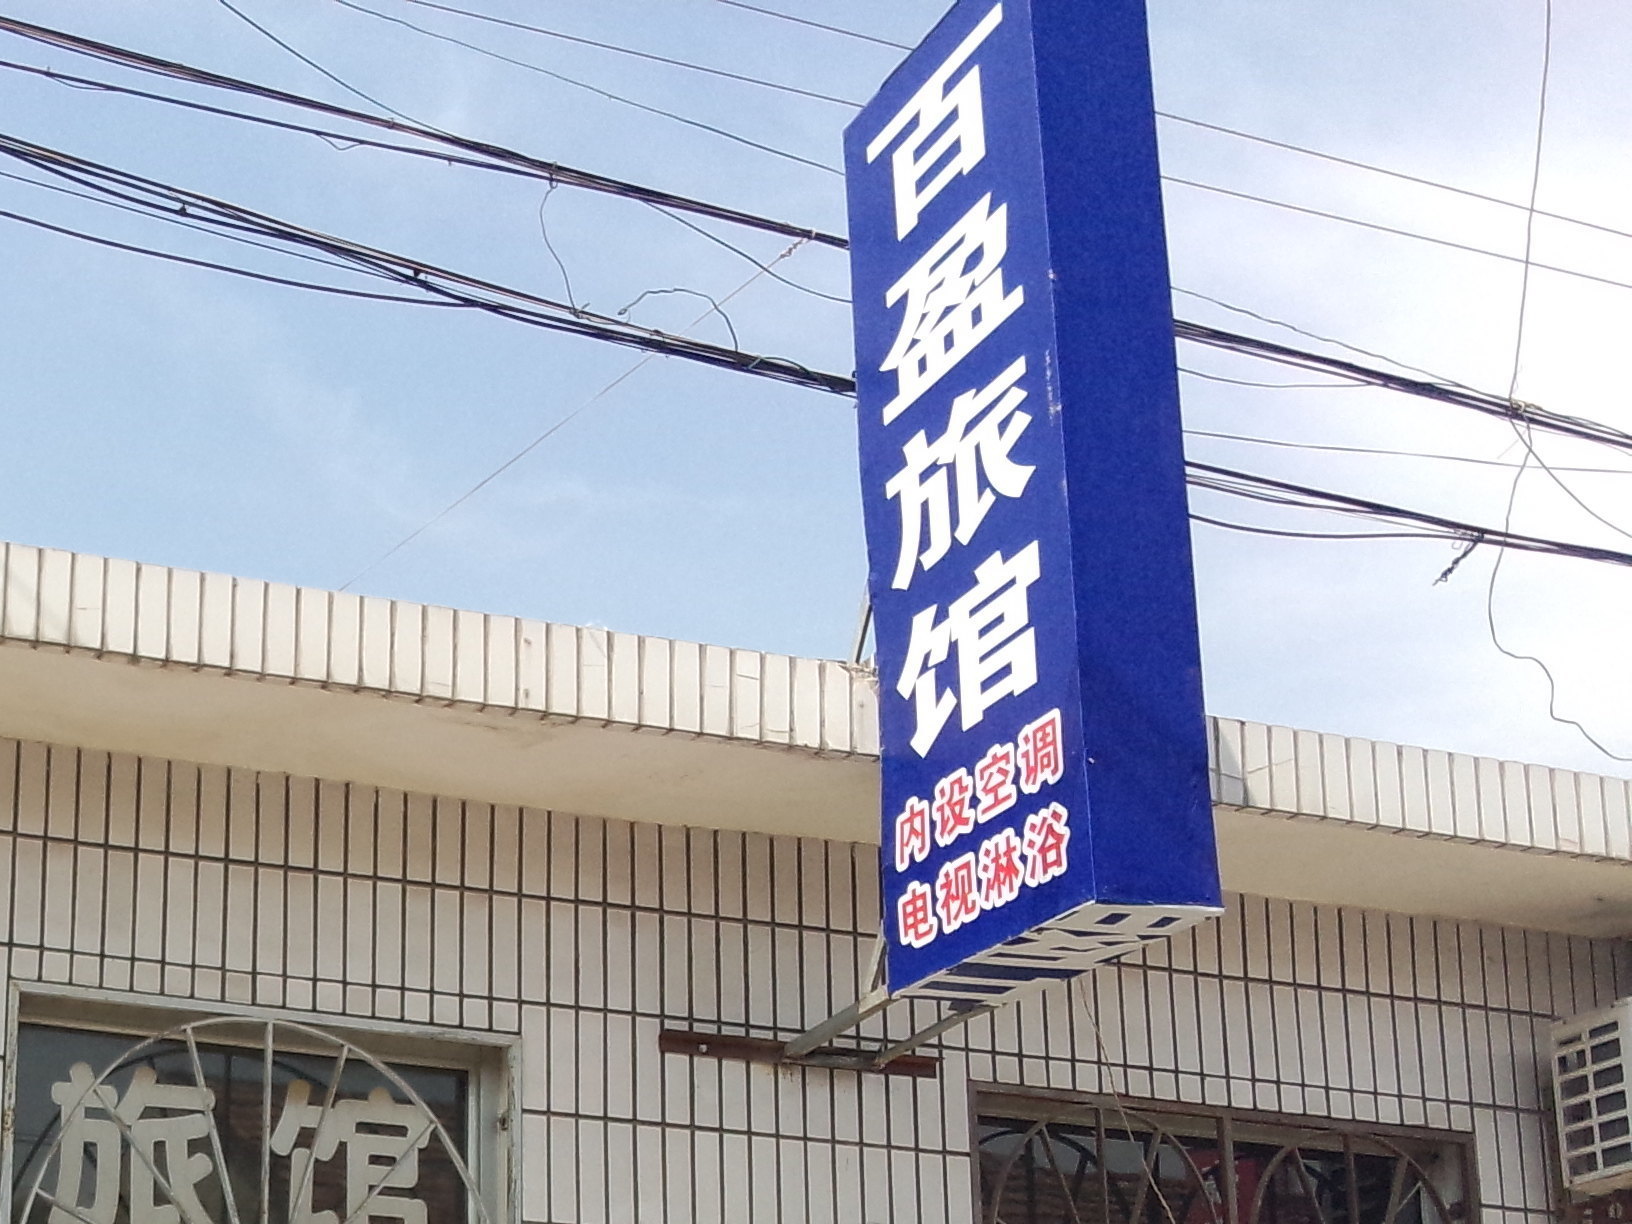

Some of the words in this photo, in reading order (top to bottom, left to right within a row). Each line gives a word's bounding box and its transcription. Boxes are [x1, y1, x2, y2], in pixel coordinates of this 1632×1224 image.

[866, 2, 1041, 759] 百盈旅馆
[896, 708, 1064, 871] 内设空调
[898, 802, 1069, 948] 电视淋浴
